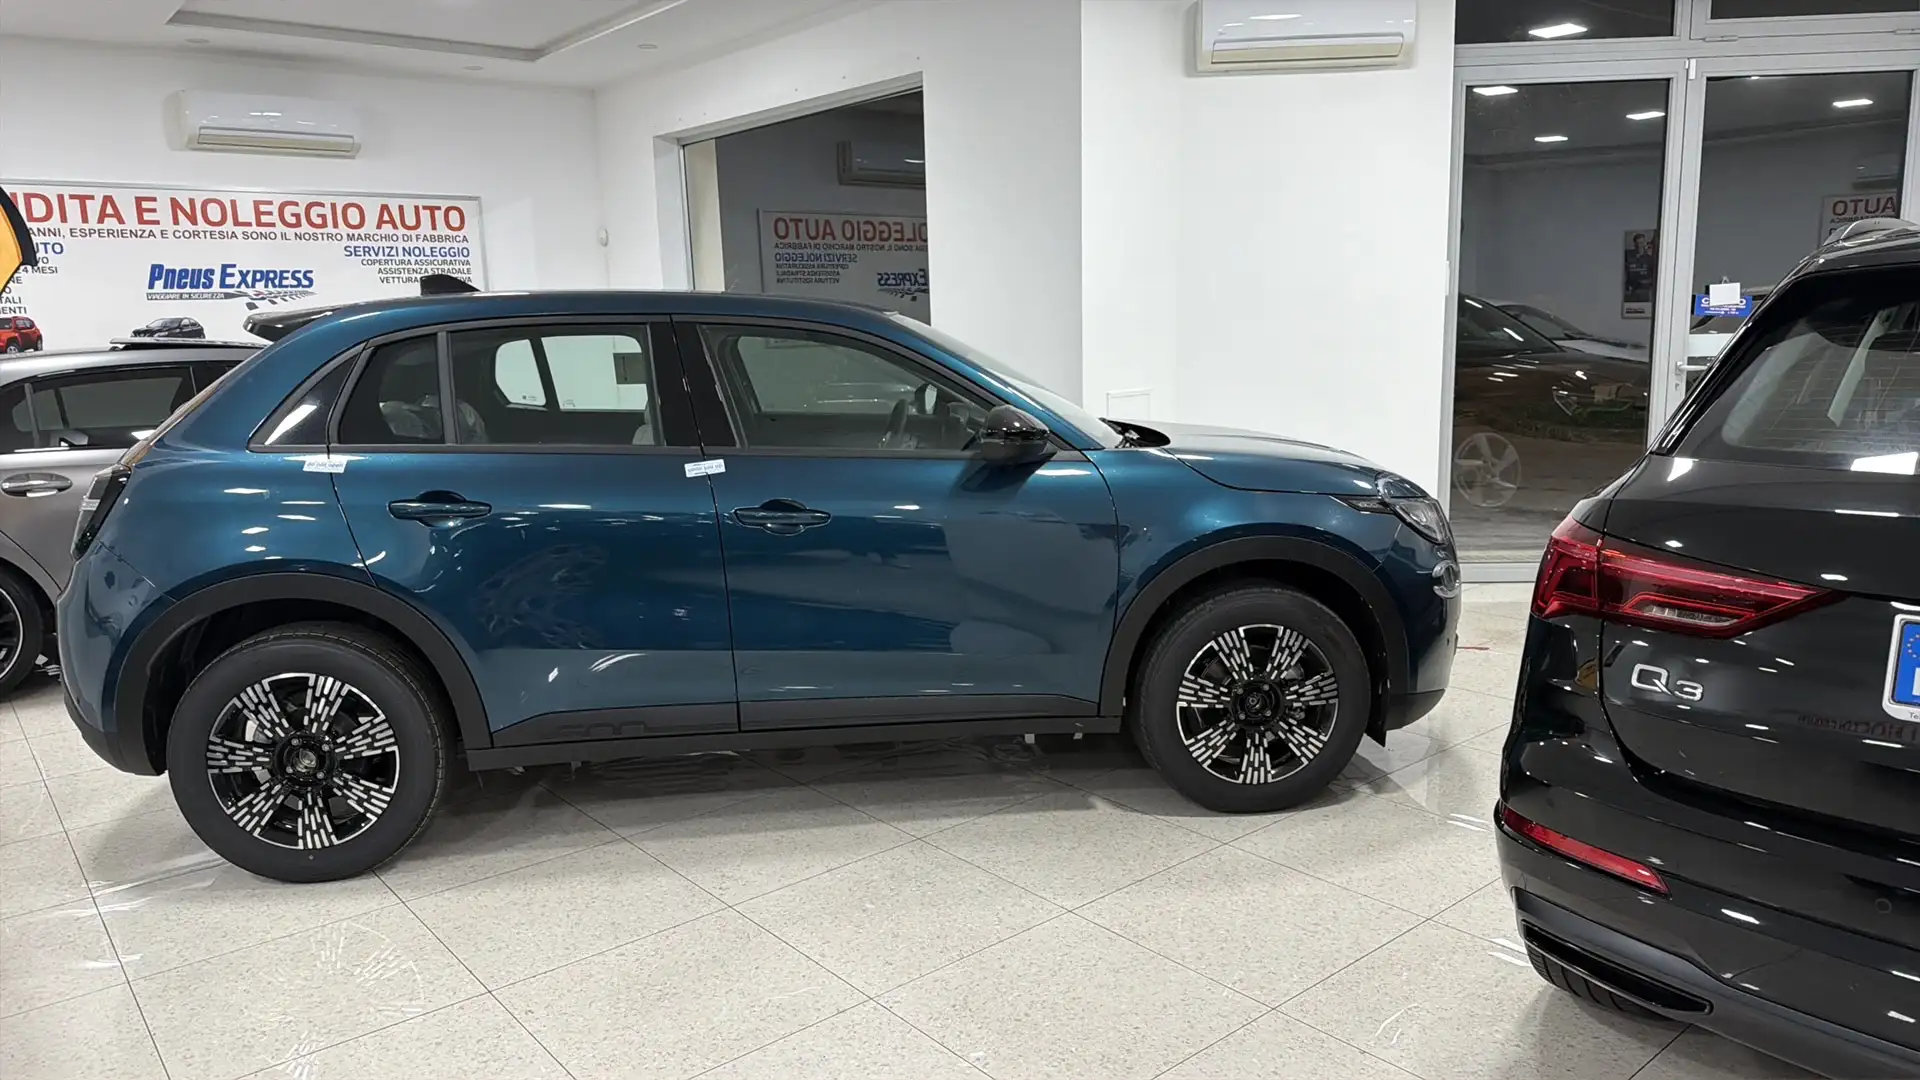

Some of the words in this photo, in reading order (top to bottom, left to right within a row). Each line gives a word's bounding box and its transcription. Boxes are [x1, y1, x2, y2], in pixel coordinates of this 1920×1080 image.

[134, 195, 161, 226] E
[169, 197, 366, 231] NOLEGGIO
[376, 204, 466, 232] AUTO
[69, 228, 157, 240] ESPERIENZA
[161, 229, 169, 240] E
[172, 229, 239, 241] CORTESIA
[244, 231, 277, 241] SONO
[281, 231, 291, 241] IL
[294, 232, 343, 242] NOSTRO
[346, 233, 399, 243] MARCHIO
[402, 234, 413, 243] DI
[416, 234, 469, 244] FABBRICA
[344, 245, 399, 258] SERVIZI
[402, 246, 470, 259] NOLEGGIO
[32, 266, 58, 274] MESI
[361, 259, 412, 267] COPERTURA
[414, 259, 471, 267] ASSICURATIVA
[147, 263, 216, 290] Pneus
[377, 267, 429, 275] ASSISTENZA
[430, 267, 472, 275] STRADALE
[379, 276, 419, 285] VETTURA
[1630, 663, 1704, 702] Q3
